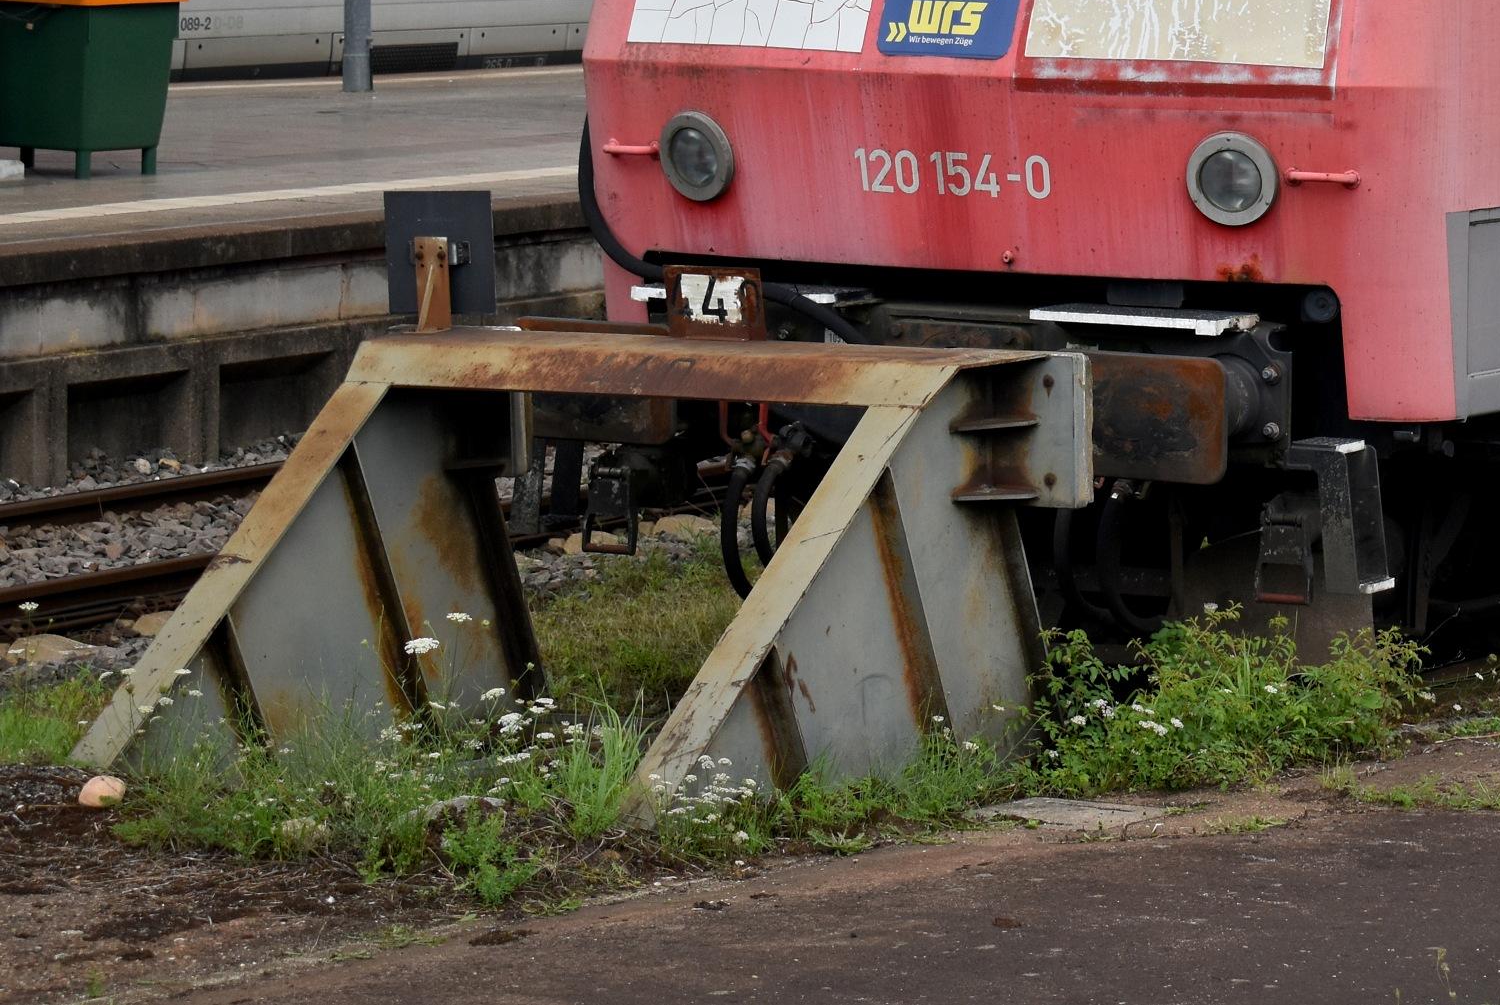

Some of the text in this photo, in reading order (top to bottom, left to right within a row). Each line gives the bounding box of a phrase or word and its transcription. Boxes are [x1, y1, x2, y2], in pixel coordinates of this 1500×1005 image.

[180, 16, 212, 32] 089-2
[909, 36, 973, 46] Wir bewegen Züge
[854, 148, 1051, 199] 120 154-0
